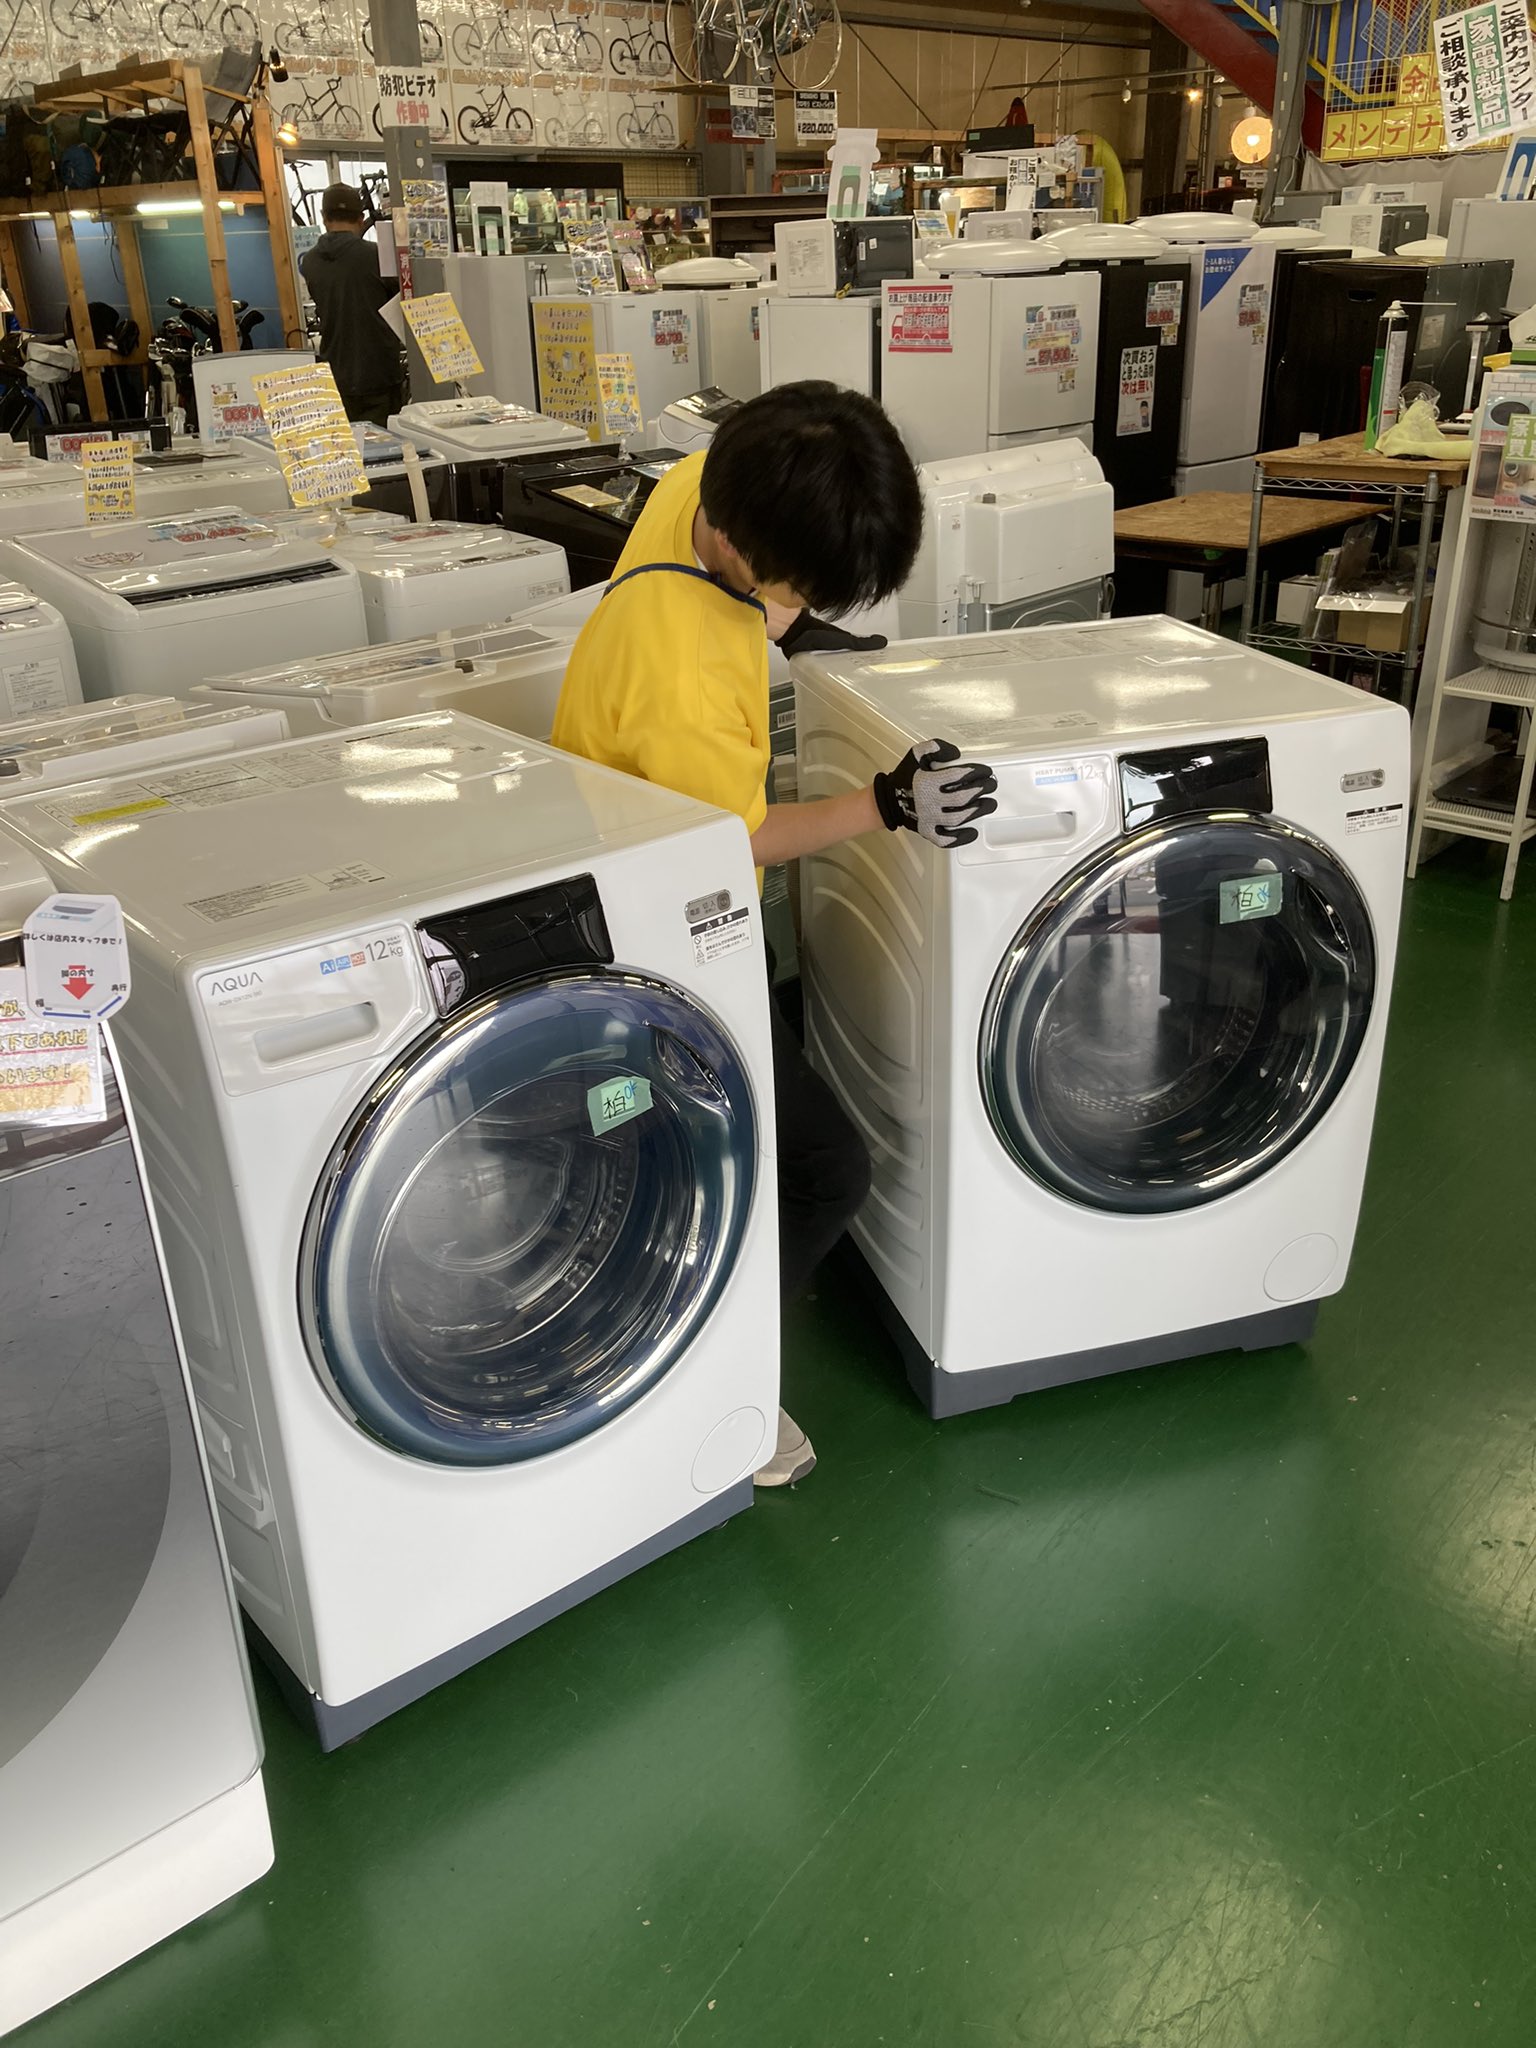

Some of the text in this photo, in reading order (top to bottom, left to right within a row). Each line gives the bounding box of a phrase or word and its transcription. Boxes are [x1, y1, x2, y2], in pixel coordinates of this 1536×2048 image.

[1468, 14, 1507, 128] 家電製品
[1500, 1, 1534, 121] ご案内カウンター
[379, 74, 436, 98] 防犯ビデオ
[1440, 17, 1475, 142] ご相談承ります
[396, 100, 430, 124] 作動中
[365, 940, 403, 961] 12 kg
[211, 972, 264, 996] AQUA
